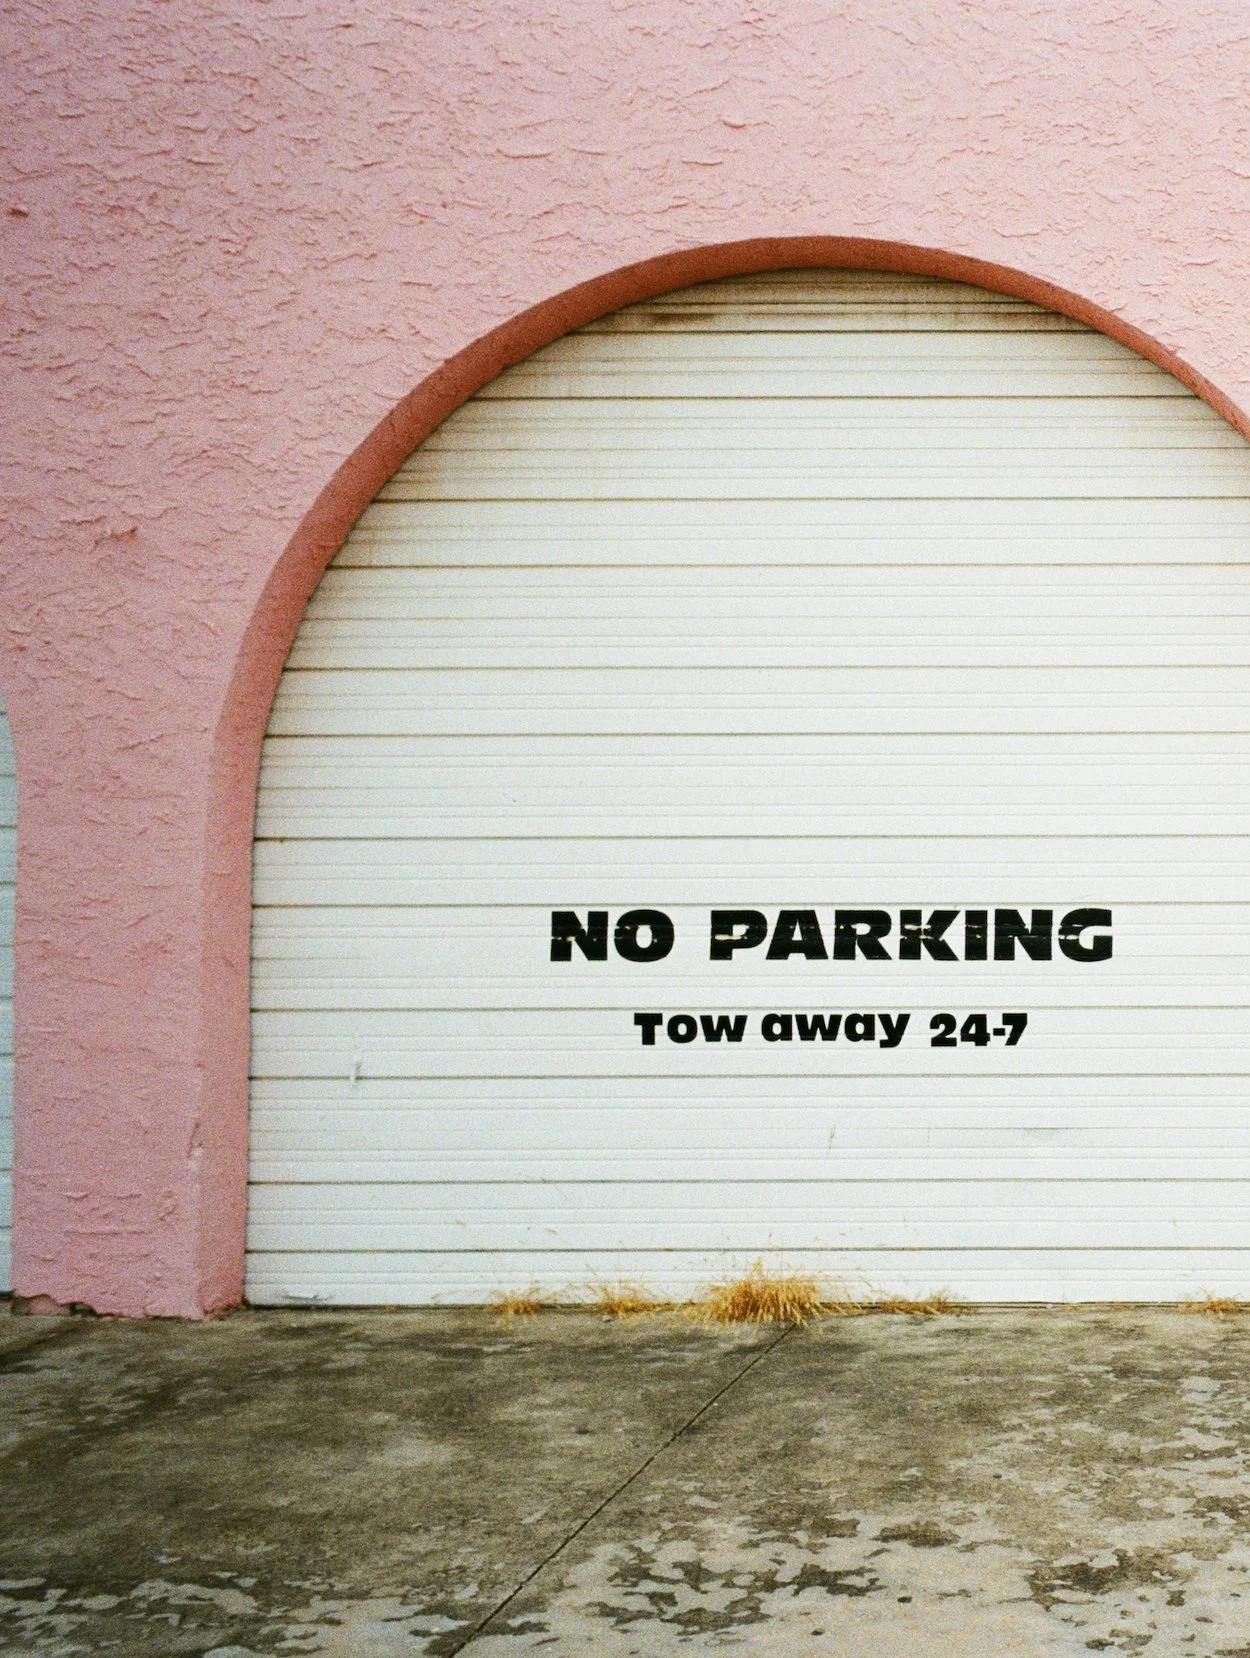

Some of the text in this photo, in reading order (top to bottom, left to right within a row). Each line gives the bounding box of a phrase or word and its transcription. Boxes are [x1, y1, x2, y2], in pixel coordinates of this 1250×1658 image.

[550, 908, 1113, 962] NO PARKING
[634, 1012, 1028, 1048] Tow away 24-7
